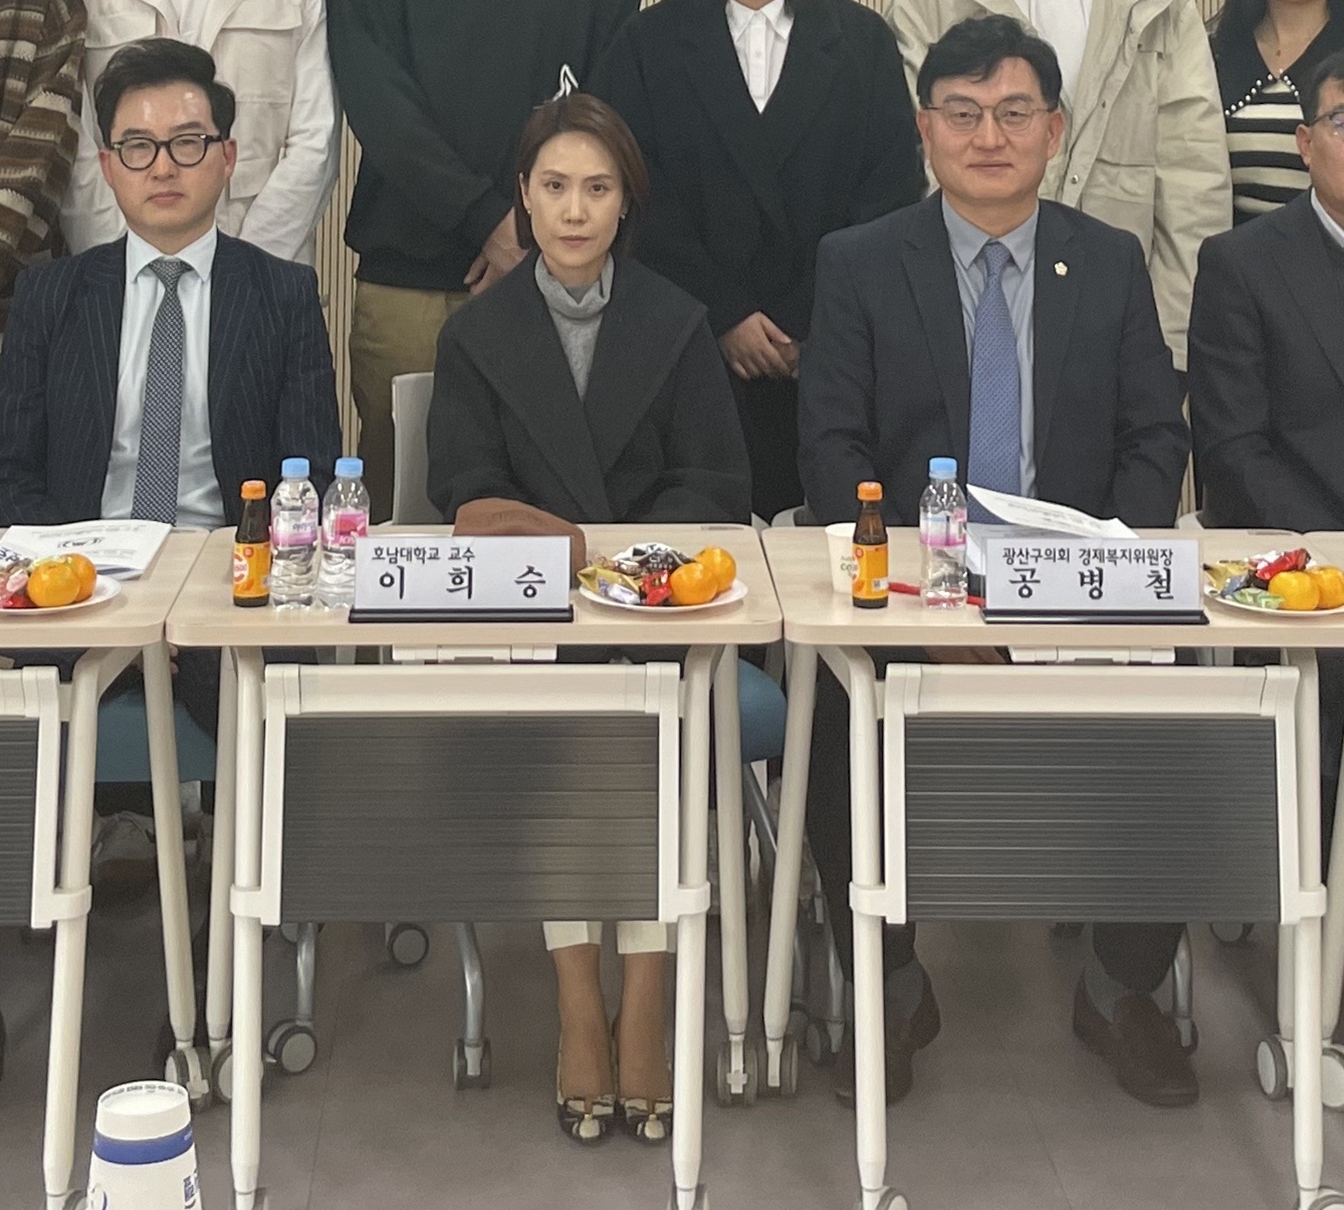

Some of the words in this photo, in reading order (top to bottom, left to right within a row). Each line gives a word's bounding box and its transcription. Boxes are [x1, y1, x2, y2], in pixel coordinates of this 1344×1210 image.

[371, 546, 441, 565] 호남대학교
[448, 546, 476, 564] 교수
[1002, 547, 1070, 566] 광산구의회
[1078, 547, 1174, 567] 경제복지위원장
